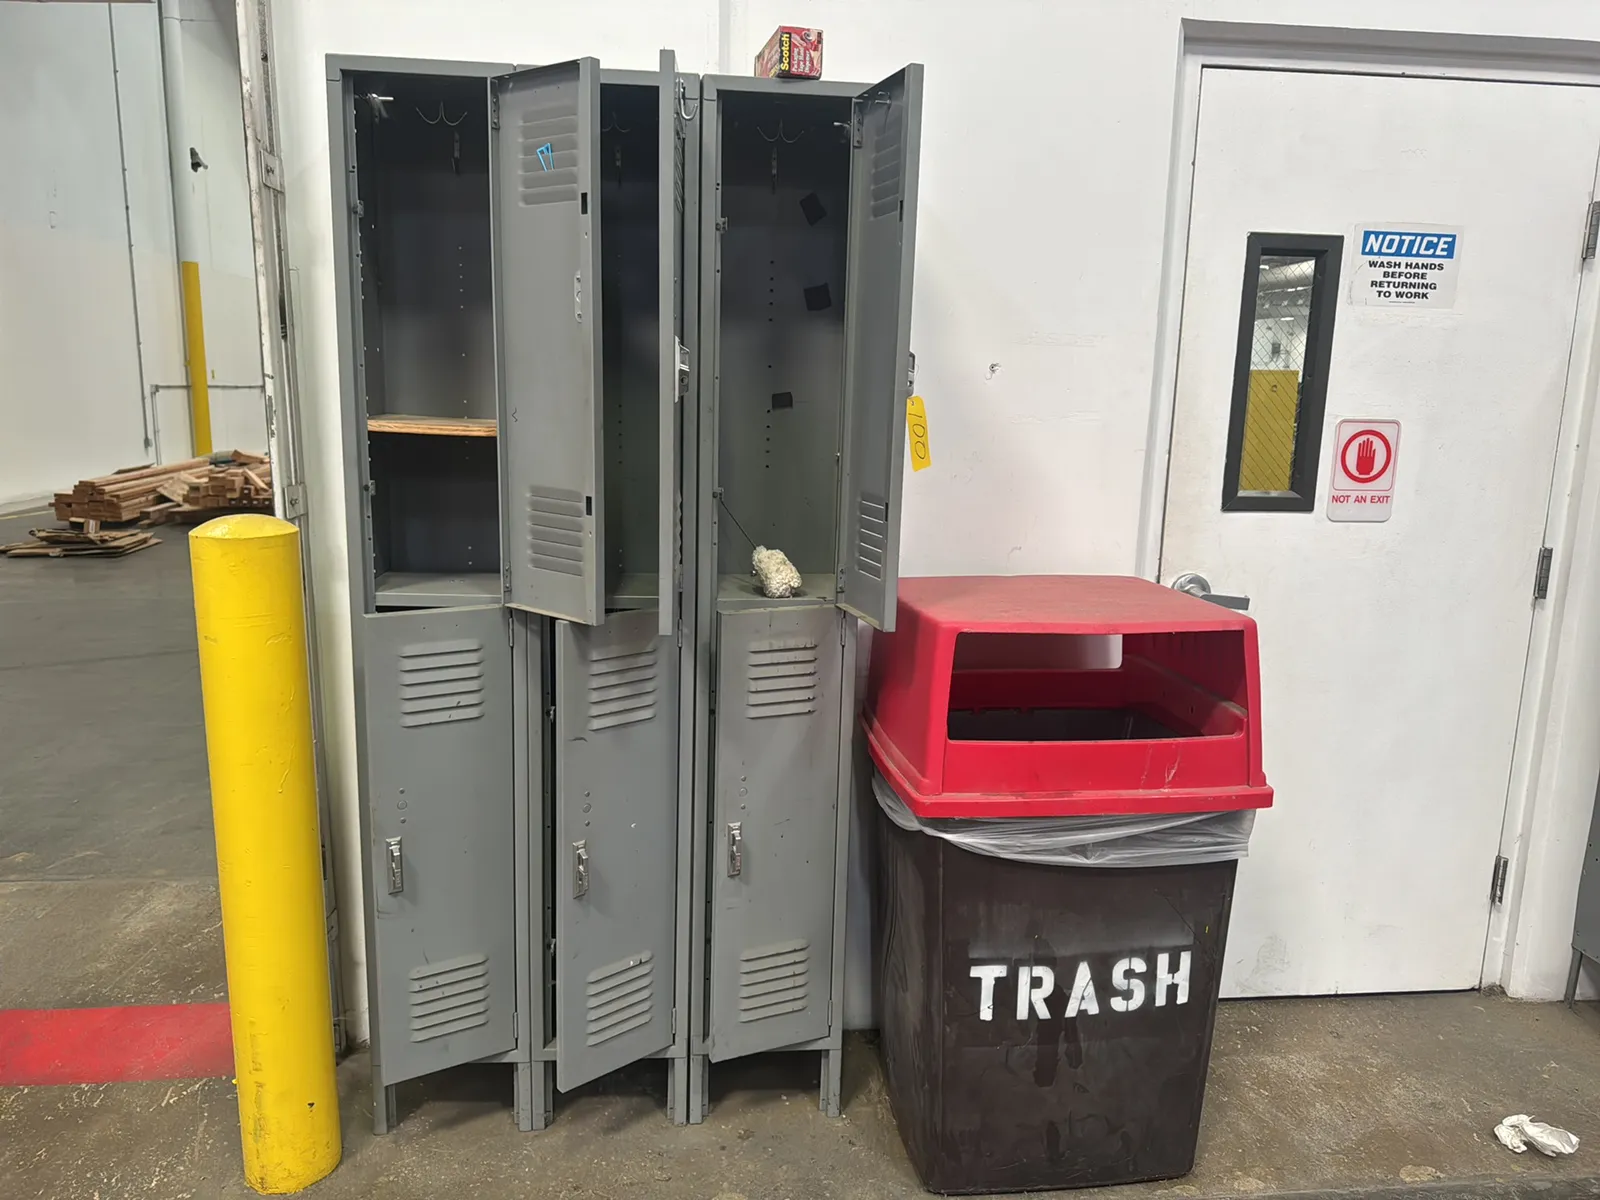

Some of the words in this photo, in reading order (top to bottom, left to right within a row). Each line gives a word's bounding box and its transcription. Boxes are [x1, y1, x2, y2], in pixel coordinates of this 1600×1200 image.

[780, 33, 790, 71] Scotch
[1364, 233, 1453, 256] NOTICE
[1368, 260, 1401, 269] WASH
[1404, 261, 1444, 271] HANDS
[1382, 271, 1427, 280] BEFORE
[1370, 280, 1437, 290] RETURNING
[1376, 290, 1391, 298] TO
[1395, 291, 1429, 300] WORK
[907, 412, 927, 460] 100
[1331, 495, 1351, 504] NOT
[1353, 495, 1367, 504] AN
[1370, 495, 1390, 504] EXIT
[969, 950, 1192, 1021] TRASH
